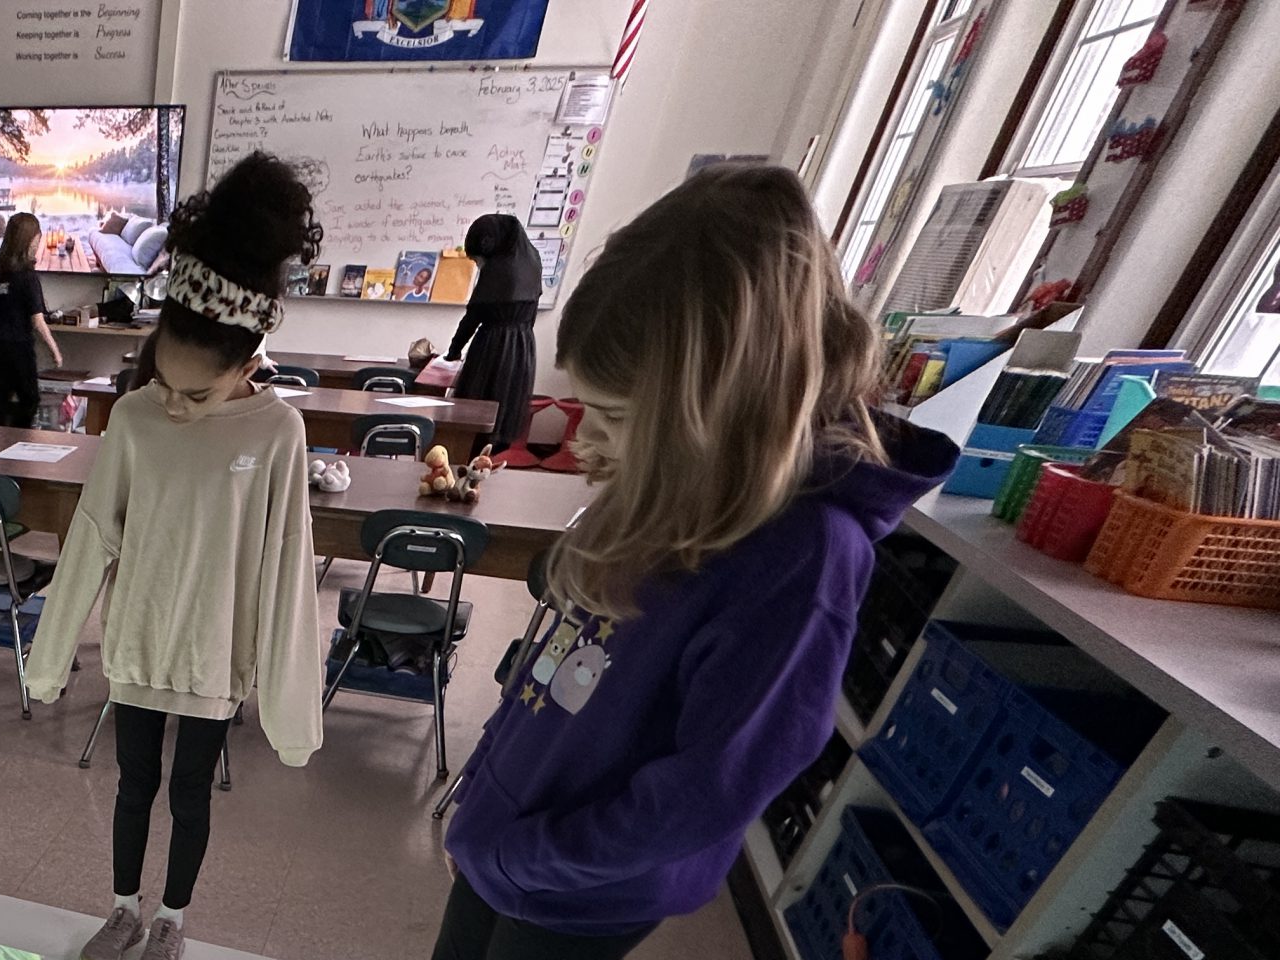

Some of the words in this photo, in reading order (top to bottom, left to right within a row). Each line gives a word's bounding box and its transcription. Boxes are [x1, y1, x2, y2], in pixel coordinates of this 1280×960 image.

[16, 11, 42, 20] Coming
[44, 10, 71, 20] together
[80, 9, 92, 17] the
[97, 3, 140, 20] Beginning
[16, 31, 42, 40] Keeping
[44, 31, 71, 40] together
[390, 35, 439, 46] EXCELSIOR
[44, 53, 70, 61] together
[72, 52, 78, 60] is
[94, 46, 125, 60] Success
[478, 76, 521, 104] February
[362, 120, 389, 139] What
[396, 121, 433, 142] happens
[433, 145, 441, 158] to
[389, 198, 404, 211] the
[397, 231, 422, 242] with
